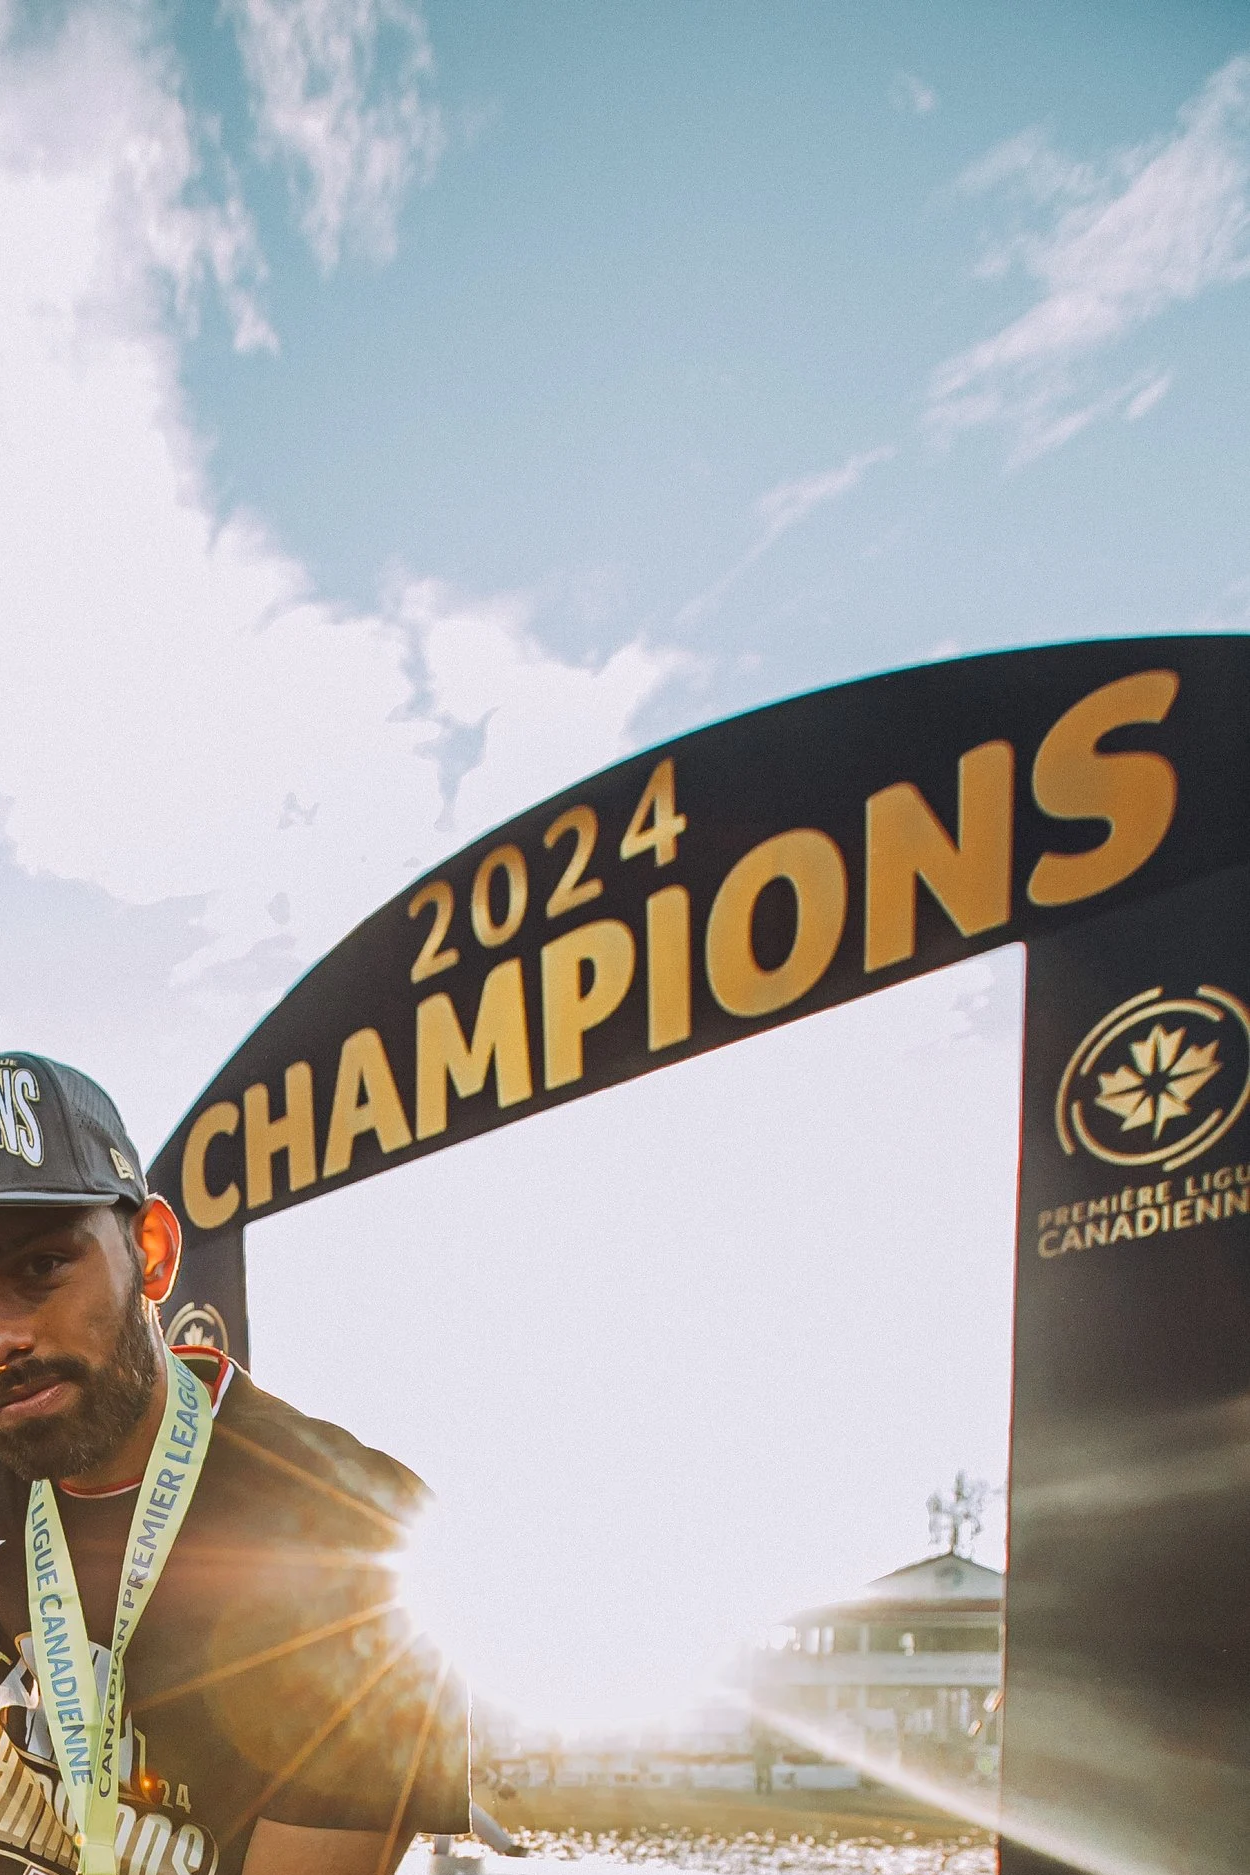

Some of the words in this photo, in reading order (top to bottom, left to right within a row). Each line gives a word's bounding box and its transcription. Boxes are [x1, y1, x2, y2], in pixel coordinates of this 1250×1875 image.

[181, 668, 1180, 1230] CHAMPIONS
[407, 756, 688, 975] 2024
[1037, 1179, 1173, 1231] PREMIÈRE
[30, 1501, 59, 1592] LIGUE
[98, 1618, 130, 1798] CANADIAN
[122, 1467, 186, 1609] PREMIER
[164, 1355, 199, 1465] LEAGUE
[39, 1593, 94, 1787] CANADIENNE
[157, 1778, 192, 1815] 24
